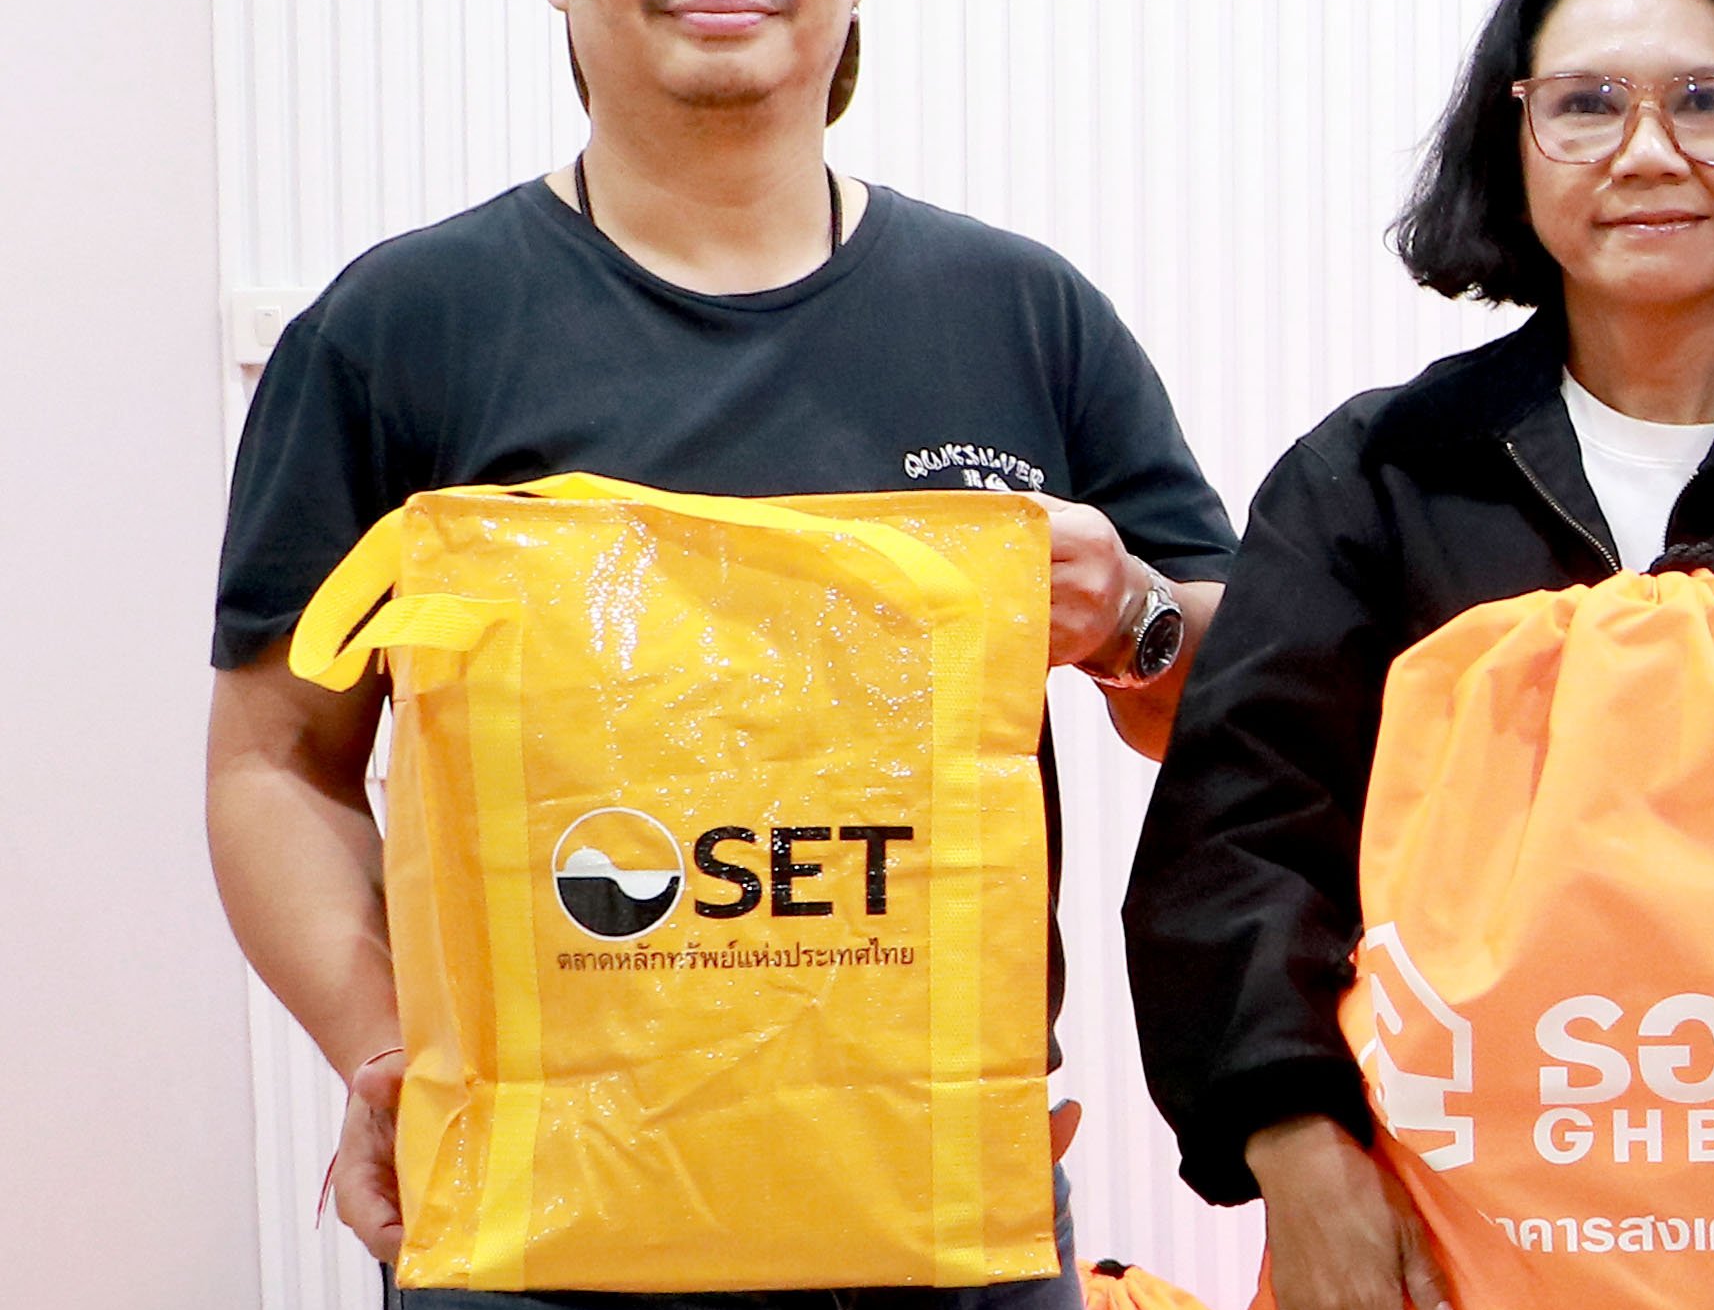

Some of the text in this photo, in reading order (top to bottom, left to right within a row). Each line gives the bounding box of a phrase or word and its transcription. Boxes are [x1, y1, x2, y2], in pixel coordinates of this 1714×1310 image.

[693, 825, 914, 920] SET
[556, 937, 914, 971] ตลาดหลักทรัพย์แห่งประเทศไทย
[1533, 1107, 1594, 1164] G
[1613, 1109, 1662, 1163] H
